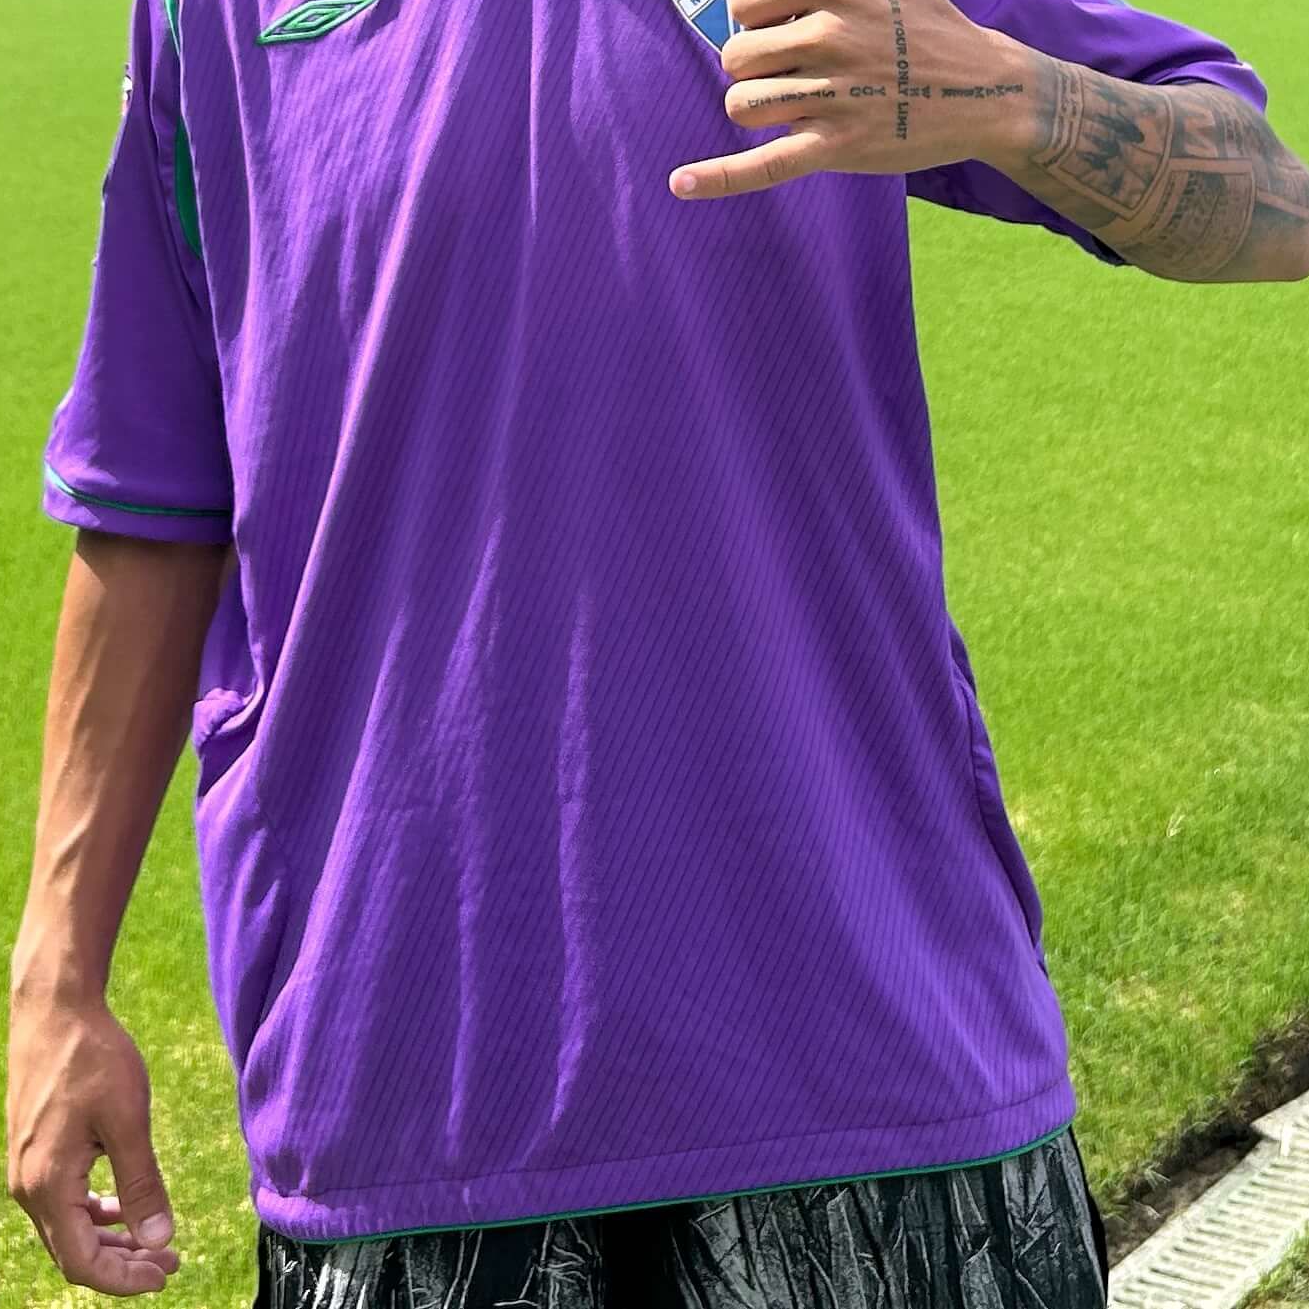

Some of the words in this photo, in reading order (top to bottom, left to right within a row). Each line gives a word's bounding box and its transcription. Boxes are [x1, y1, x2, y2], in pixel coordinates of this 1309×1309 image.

[894, 19, 908, 56] YOUR
[897, 60, 909, 96] ONLY
[896, 101, 909, 140] LIMIT
